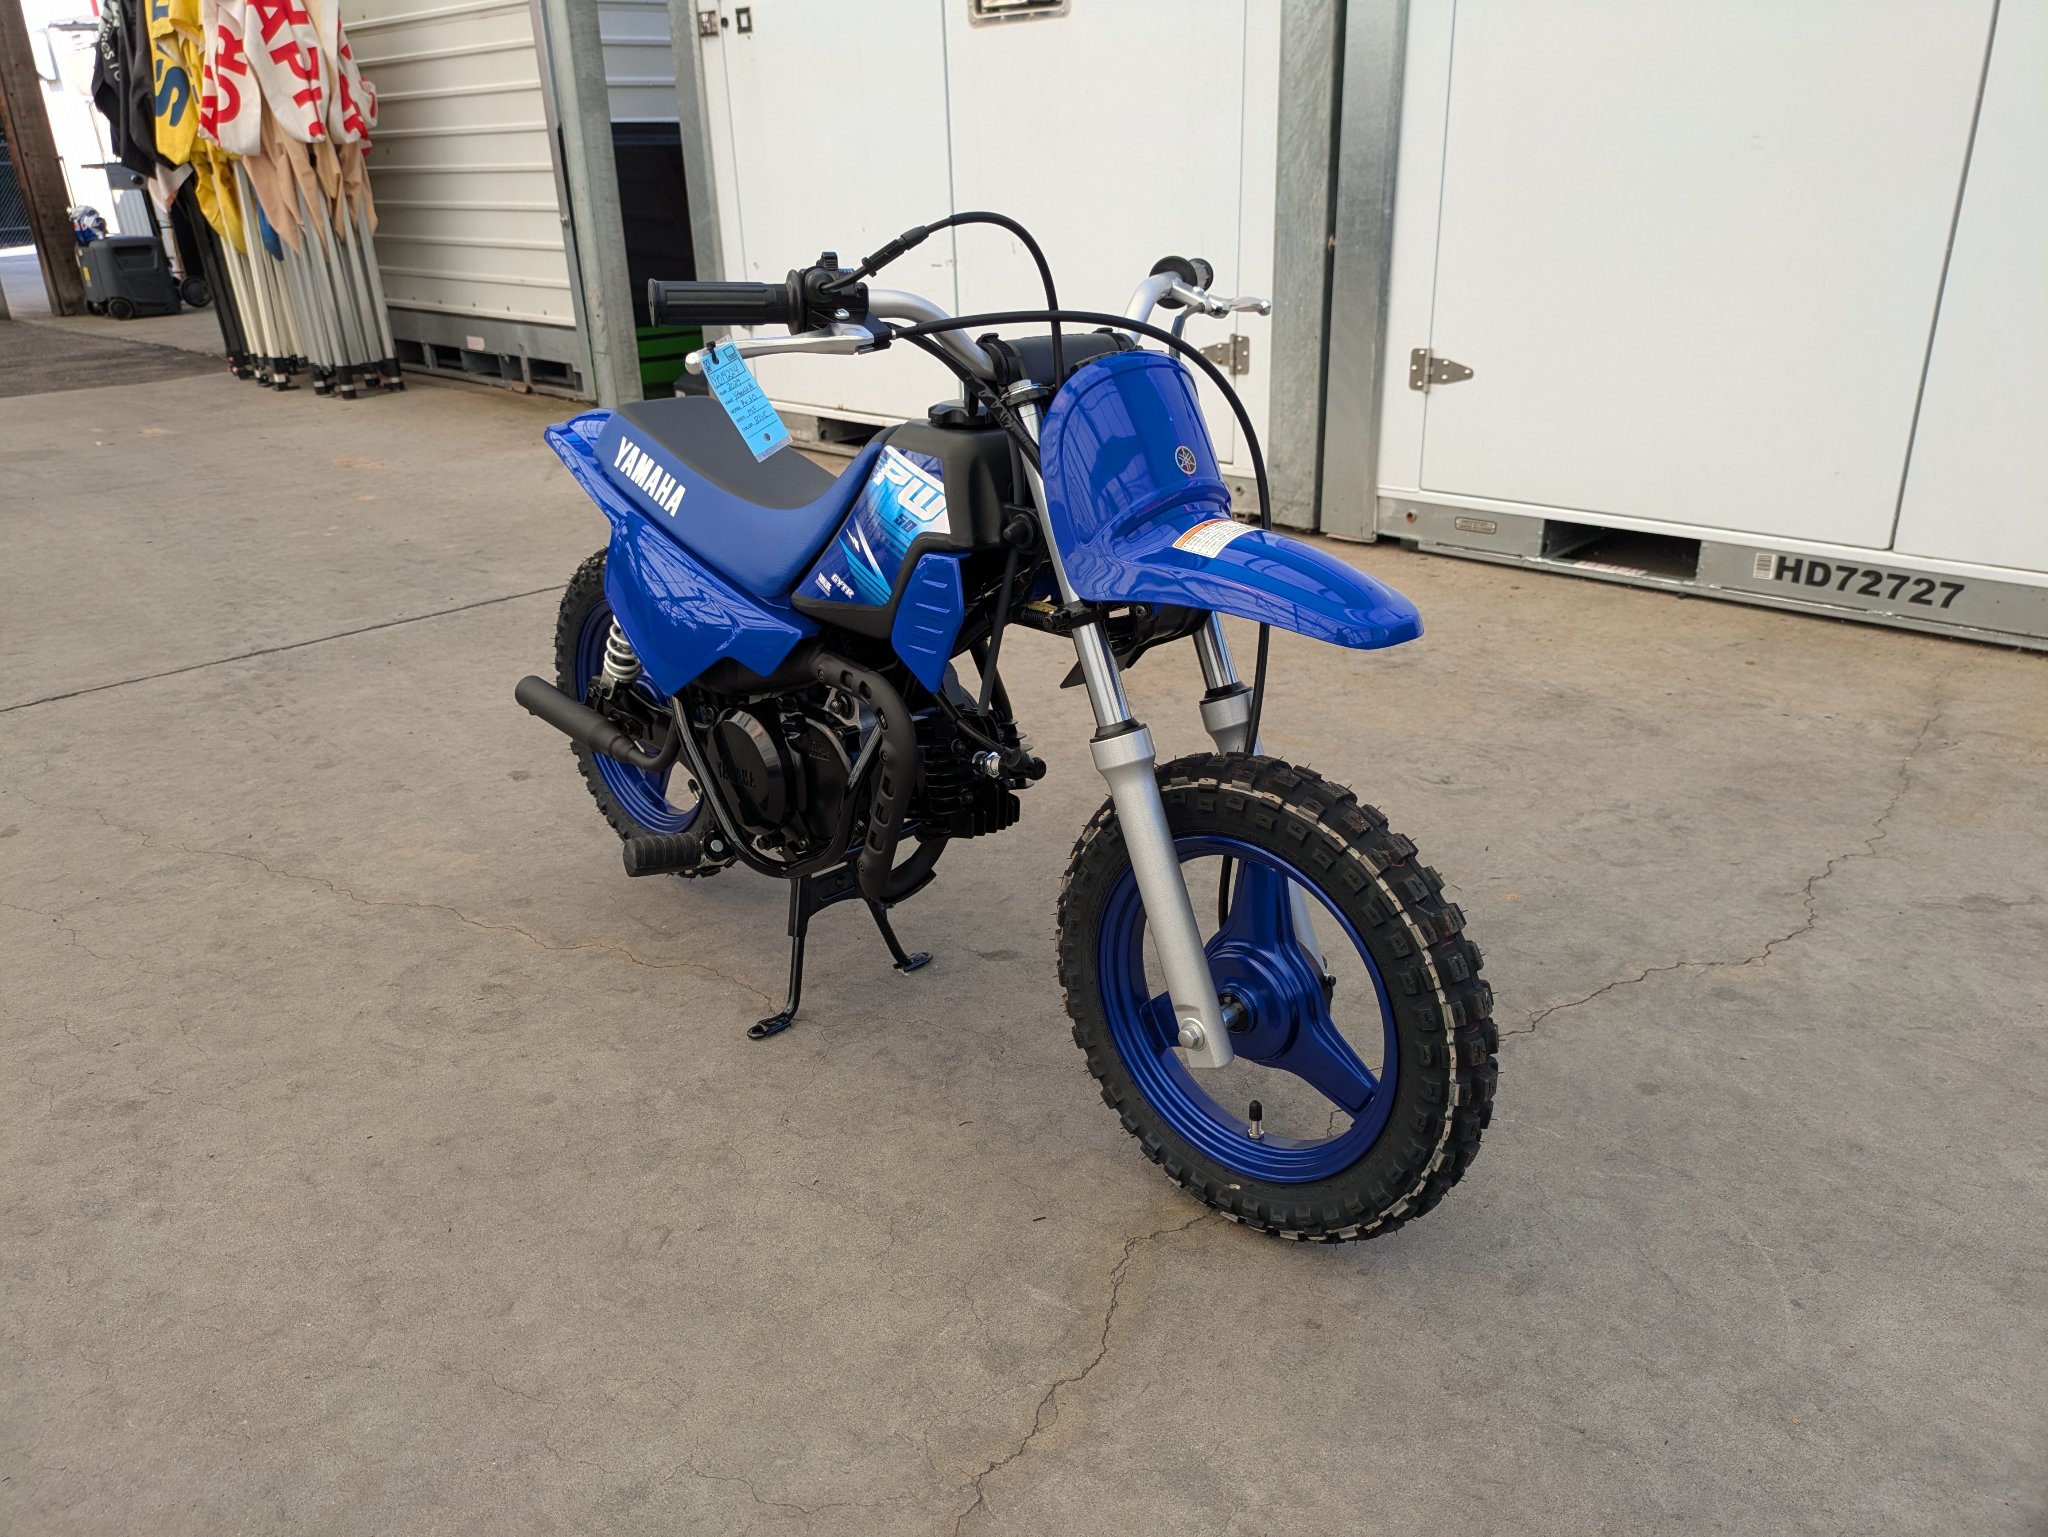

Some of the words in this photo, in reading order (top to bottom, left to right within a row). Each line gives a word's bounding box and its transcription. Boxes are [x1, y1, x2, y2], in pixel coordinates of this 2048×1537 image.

[613, 435, 686, 517] YAMAHA
[873, 456, 947, 522] PW
[893, 512, 918, 533] 50
[830, 573, 855, 599] GYTR
[1774, 556, 1965, 609] HD72727
